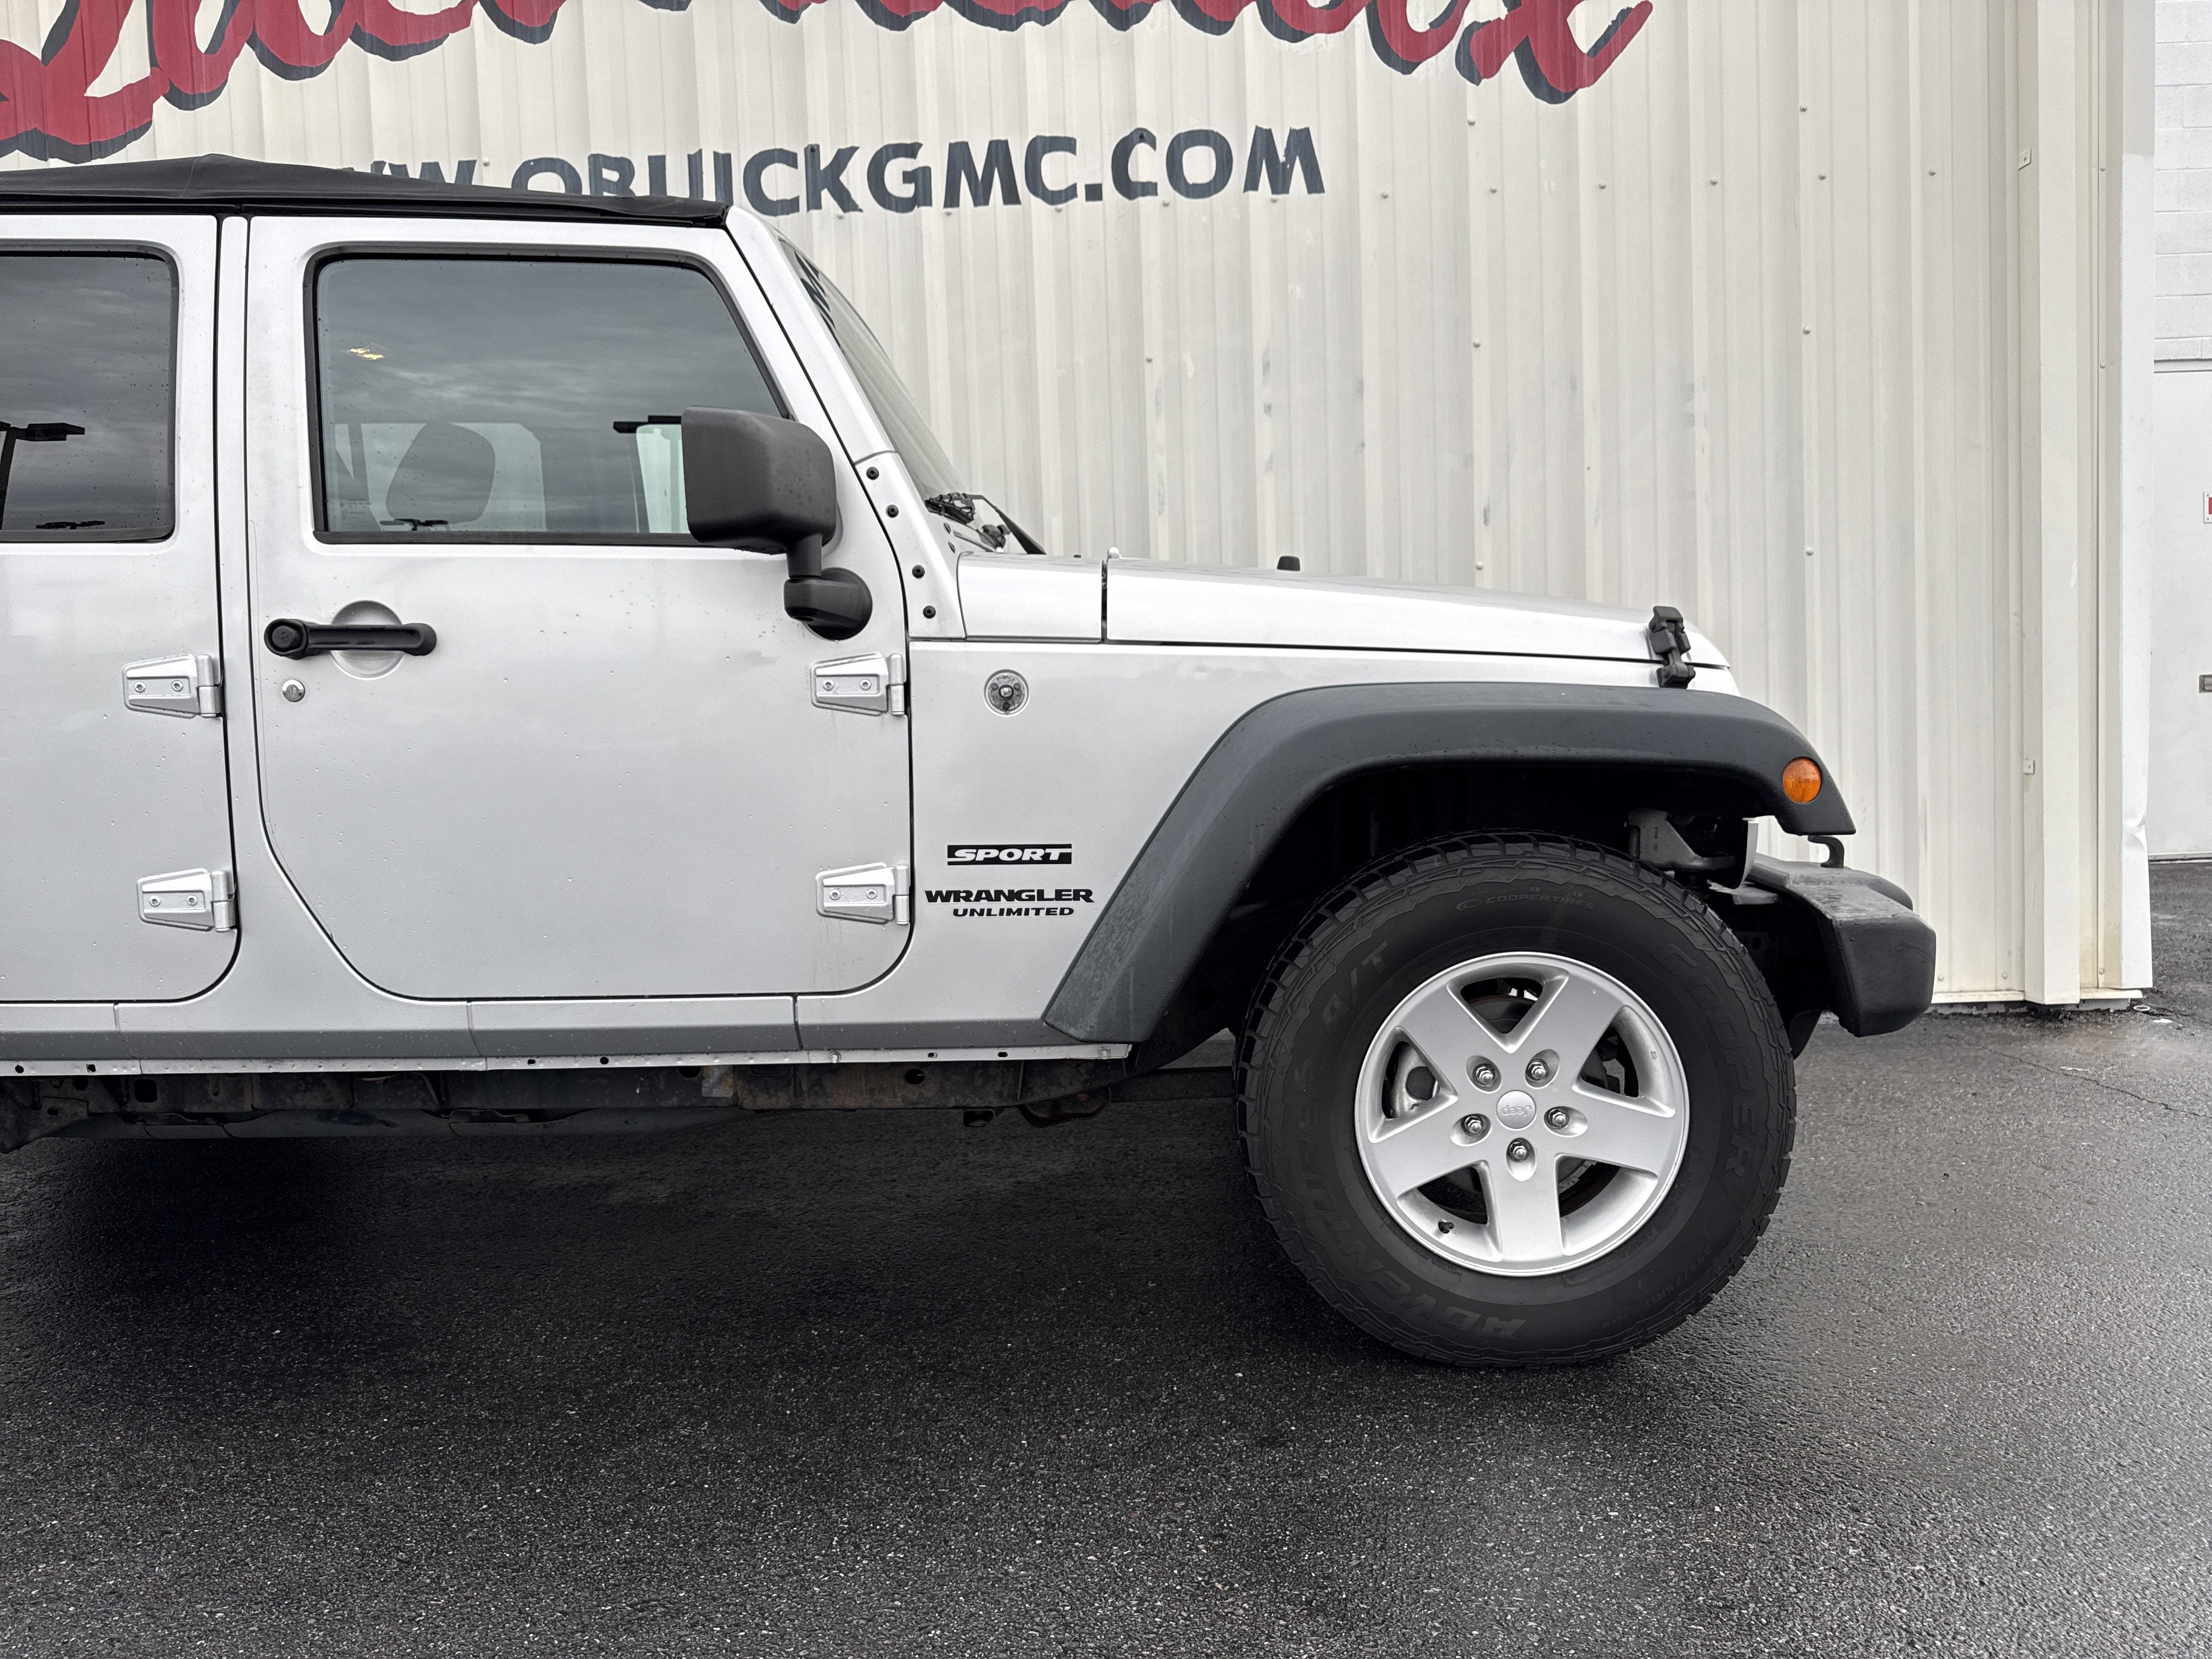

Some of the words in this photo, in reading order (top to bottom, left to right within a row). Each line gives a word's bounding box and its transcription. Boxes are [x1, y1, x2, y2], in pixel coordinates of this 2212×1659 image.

[947, 848, 1072, 862] SPORT
[925, 889, 1095, 903] WRANGLER
[952, 907, 1074, 917] UNLIMITED
[1322, 940, 1389, 1041] A/T
[1652, 943, 1756, 1178] COOPER
[1500, 1104, 1533, 1116] Jeep
